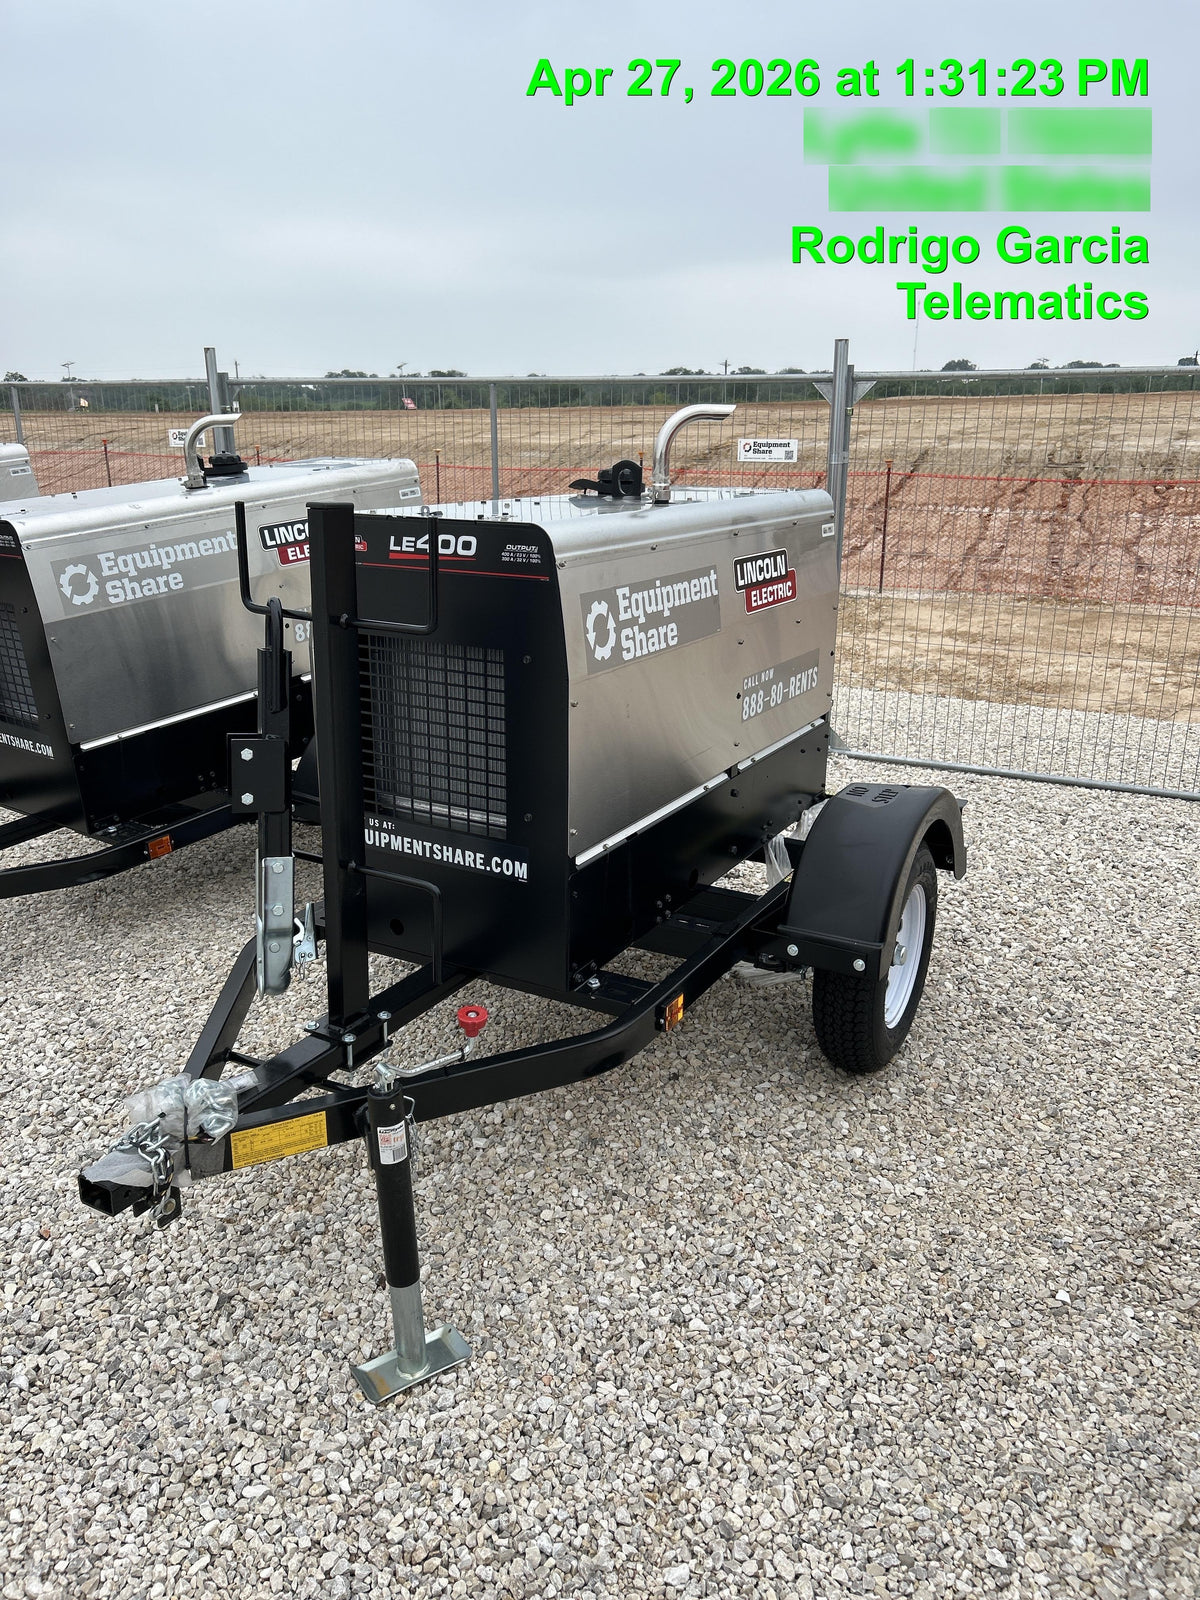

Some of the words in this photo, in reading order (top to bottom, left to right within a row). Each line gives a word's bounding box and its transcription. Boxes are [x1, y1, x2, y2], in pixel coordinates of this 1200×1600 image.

[753, 441, 790, 449] Equipment
[97, 531, 237, 577] Equipment
[389, 533, 477, 556] LE400
[737, 554, 786, 587] LINCOLN
[105, 572, 184, 604] Share
[616, 569, 719, 624] Equipment
[751, 581, 793, 607] ELECTRIC
[620, 622, 678, 661] Share
[742, 666, 818, 721] 888-80-RENTS
[743, 674, 759, 690] CALL
[761, 668, 775, 683] NOW
[846, 786, 869, 797] NO
[369, 818, 380, 827] US
[382, 821, 395, 830] AT:
[364, 828, 528, 880] UIPMENTSHARE.COM
